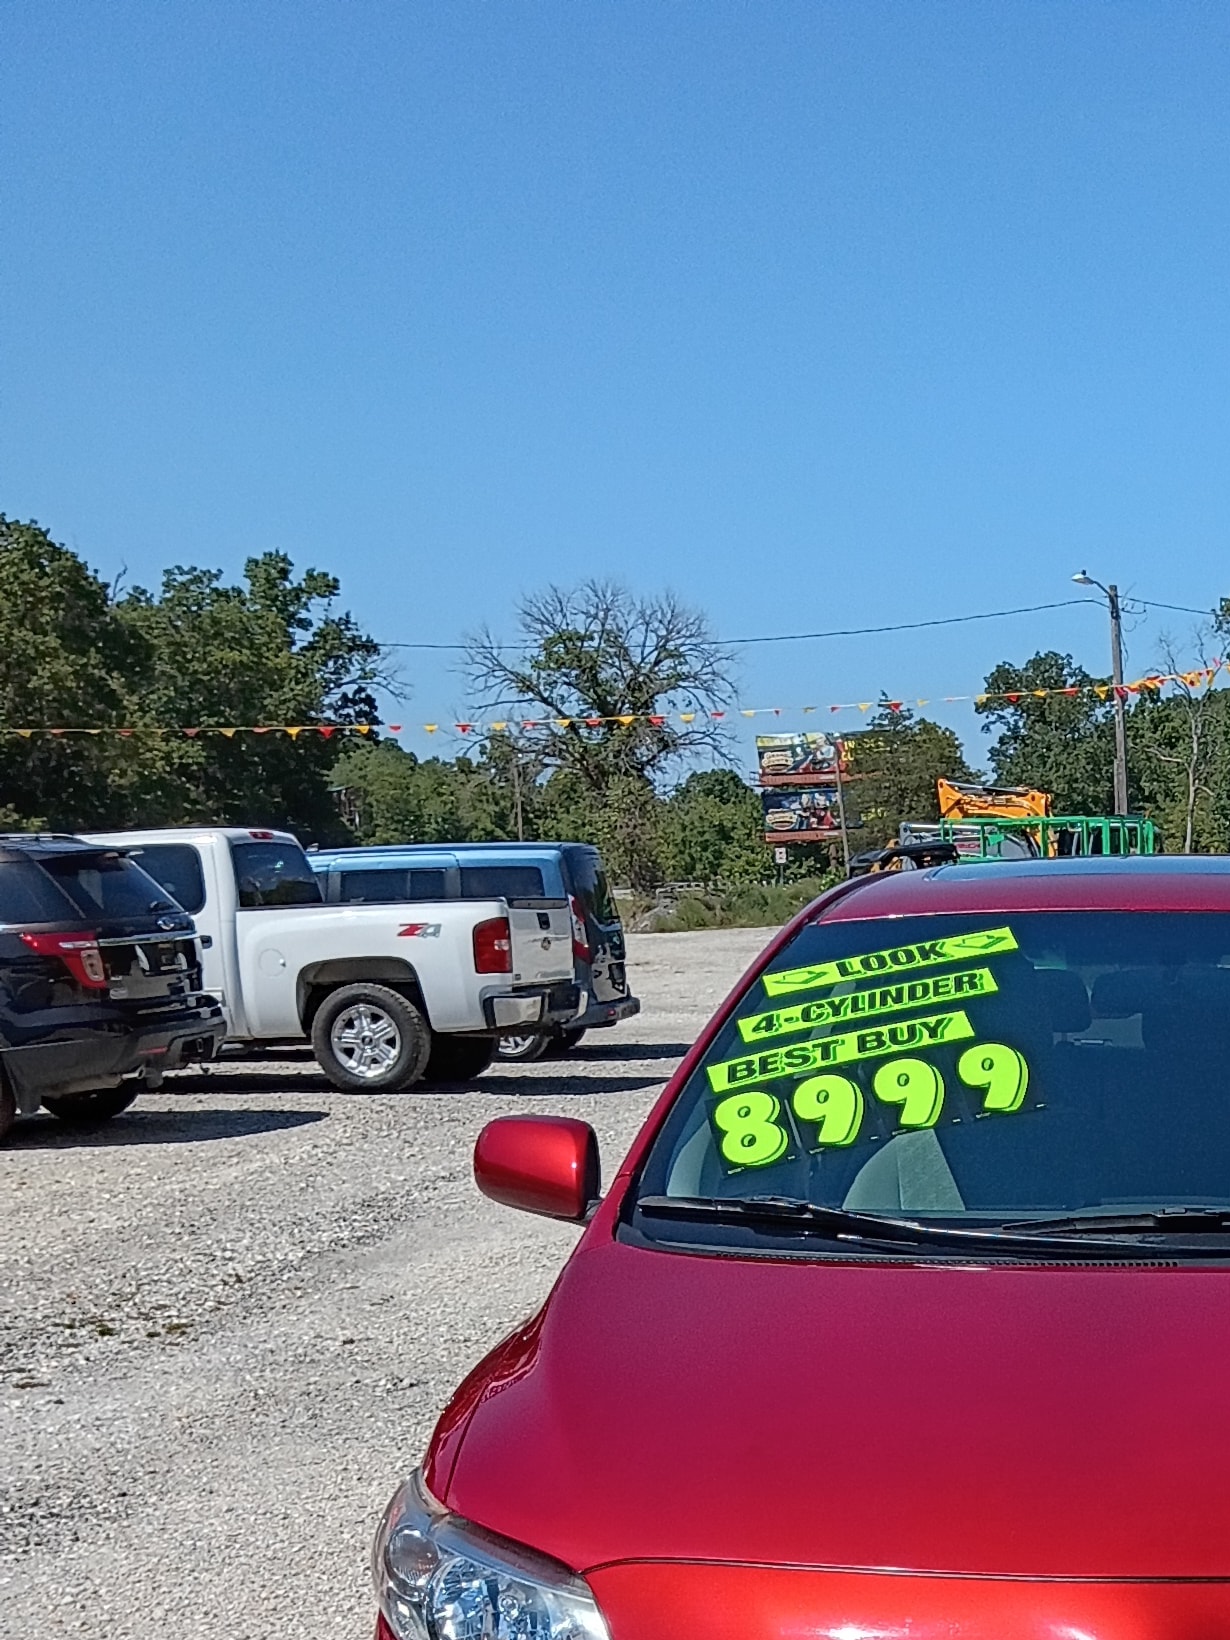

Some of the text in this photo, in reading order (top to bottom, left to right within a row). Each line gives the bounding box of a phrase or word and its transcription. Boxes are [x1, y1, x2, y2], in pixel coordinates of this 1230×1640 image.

[836, 941, 949, 978] LOOK
[751, 971, 983, 1034] 4-CYLINDER
[727, 1016, 953, 1085] BEST BUY
[714, 1042, 1030, 1168] 8999
